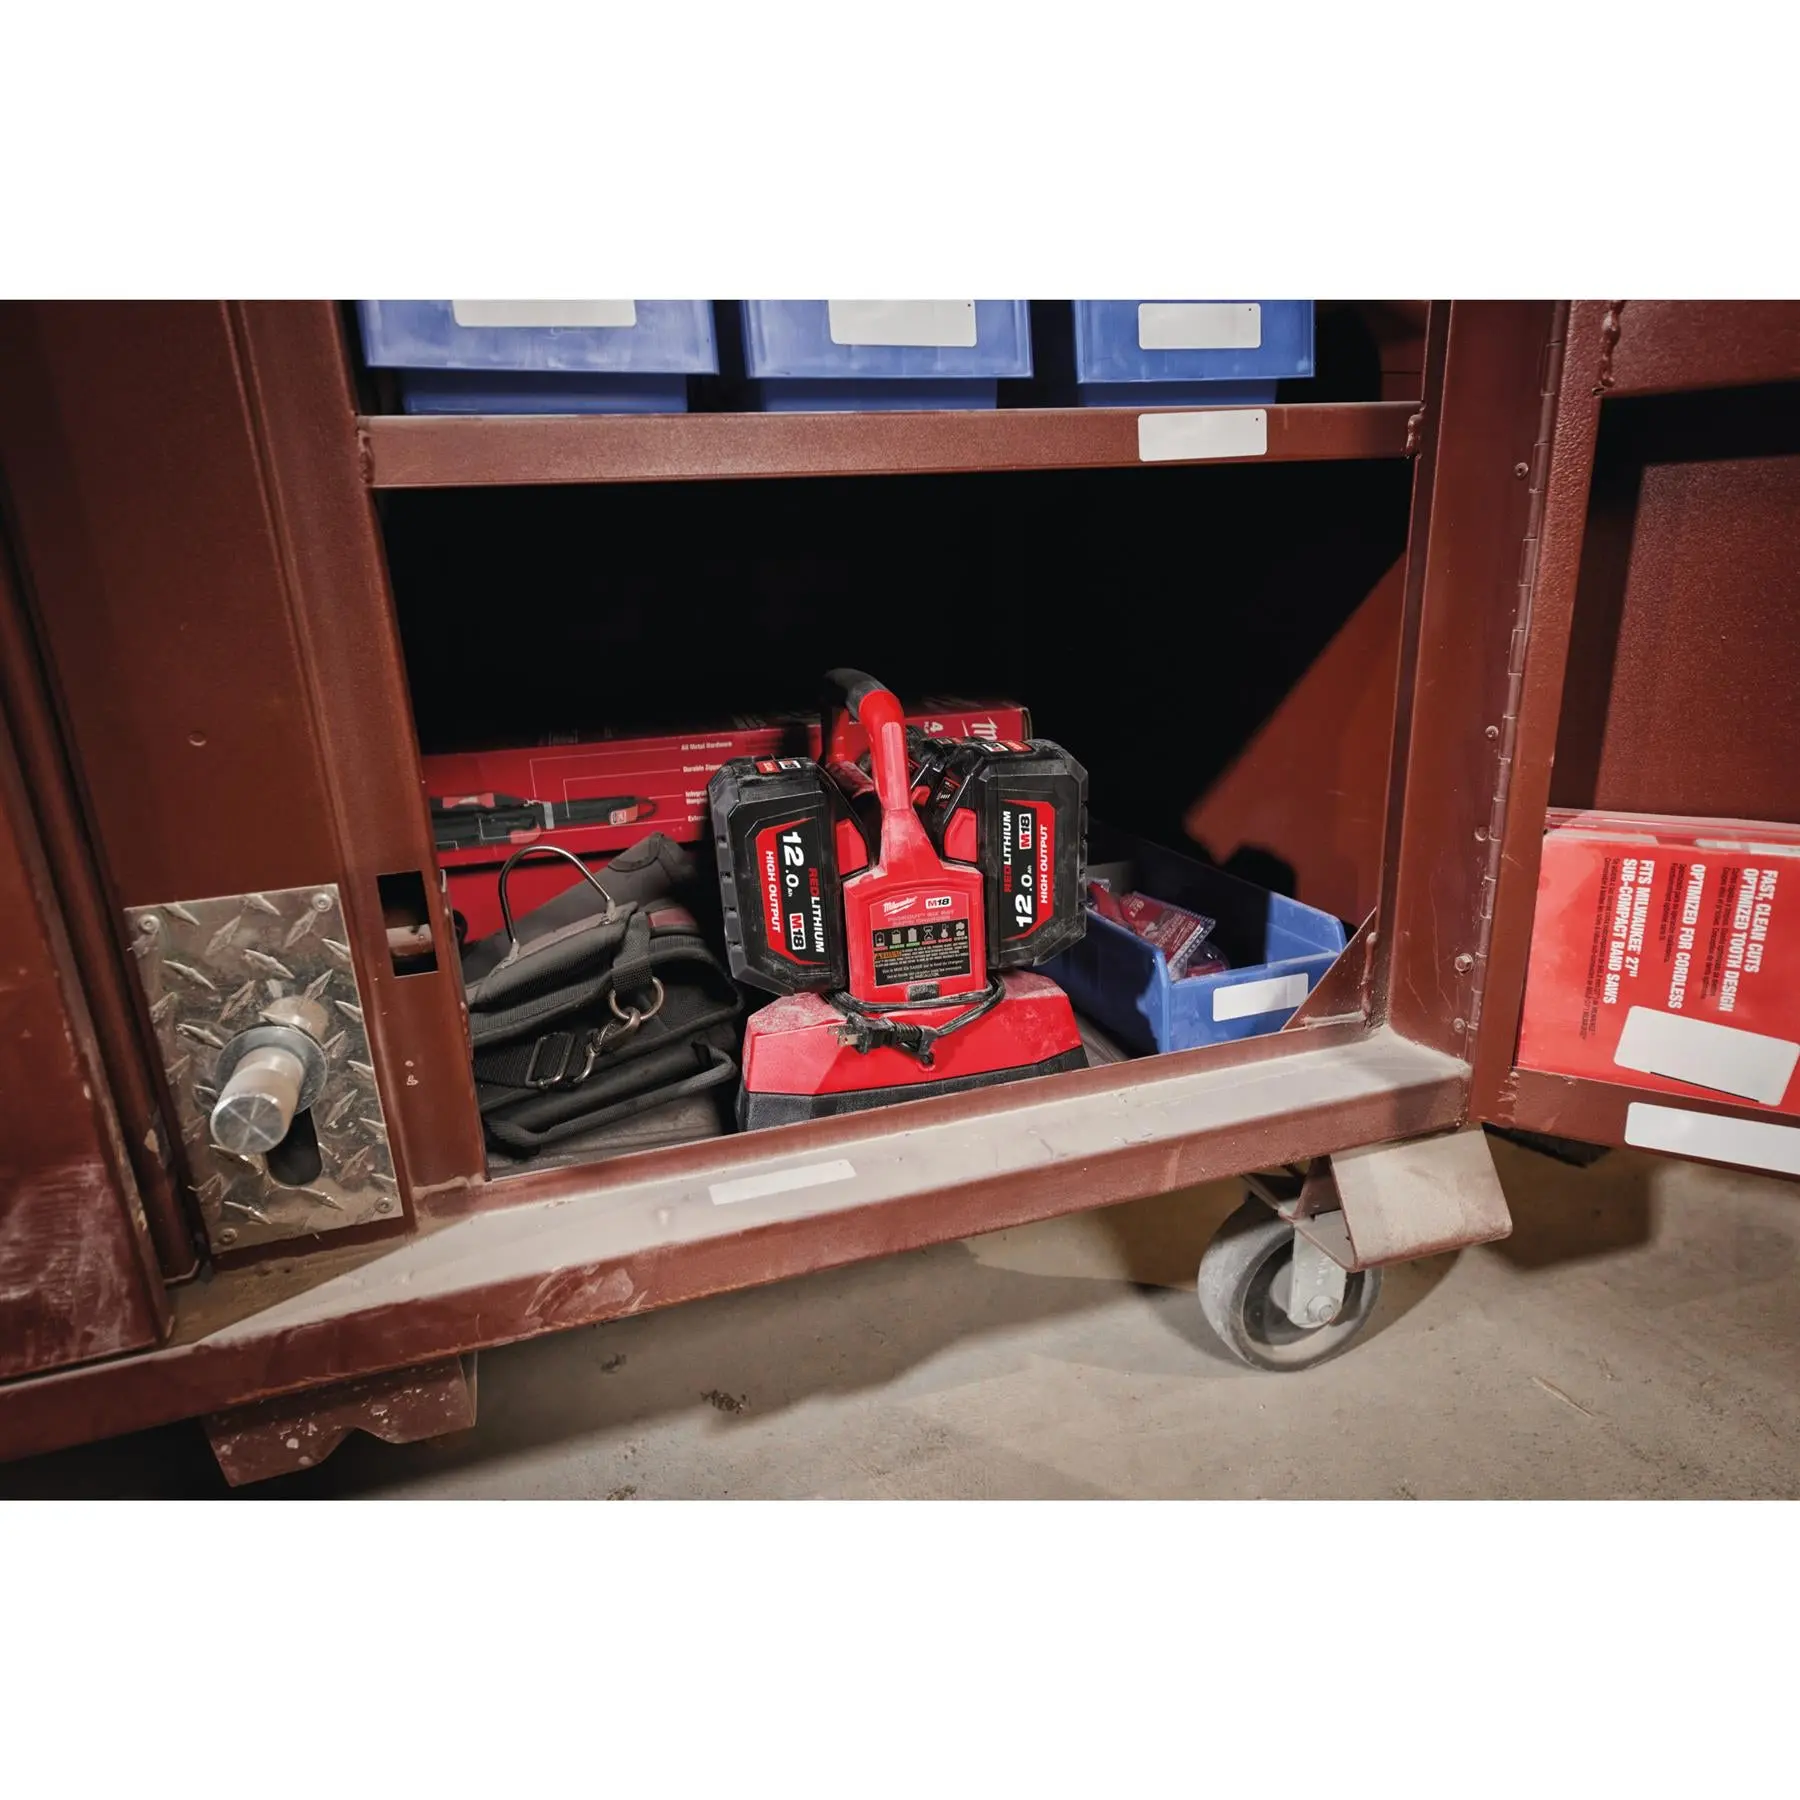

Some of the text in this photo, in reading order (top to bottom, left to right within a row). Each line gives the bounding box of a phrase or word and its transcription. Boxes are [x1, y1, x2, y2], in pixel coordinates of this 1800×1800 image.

[1020, 815, 1031, 849] M18
[1040, 824, 1048, 904] HIGH OUTPUT
[1638, 859, 1656, 885] FITS
[765, 850, 781, 933] HIGH OUTPUT
[927, 898, 950, 907] M18
[1612, 858, 1638, 939] SUB-COMPACT
[1682, 864, 1706, 925] OPTIMIZED
[1733, 868, 1759, 930] OPTIMIZED
[790, 914, 805, 948] M18
[1627, 886, 1651, 953] MILWAUKEE
[1677, 927, 1695, 950] FOR
[1744, 869, 1779, 973] FAST, CLEAN CUTS
[1607, 941, 1625, 971] BAND
[1726, 931, 1747, 968] TOOTH
[1602, 973, 1620, 1004] SAWS
[1668, 952, 1691, 1009] CORDLESS
[1718, 970, 1740, 1012] DESIGN
